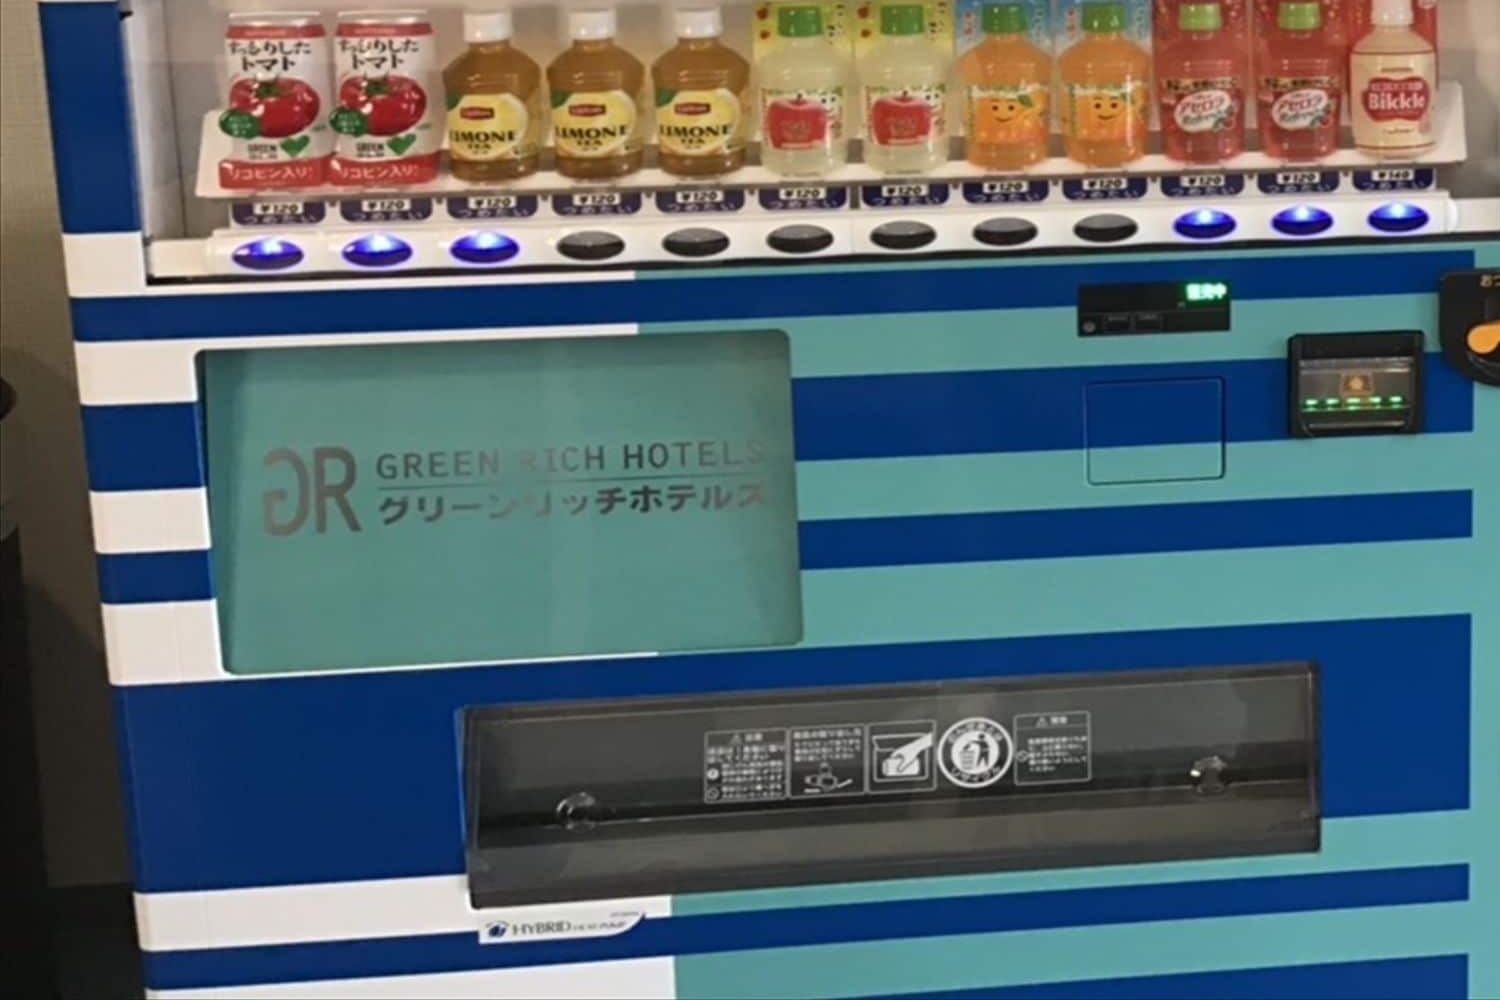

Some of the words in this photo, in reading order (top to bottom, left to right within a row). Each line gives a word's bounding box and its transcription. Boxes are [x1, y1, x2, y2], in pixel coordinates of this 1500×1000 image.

[241, 55, 296, 72] トマト
[352, 53, 404, 70] トマト
[375, 450, 498, 481] GREEN
[519, 444, 606, 473] RICH
[623, 438, 766, 470] HOTELS
[511, 920, 571, 936] HYBRID
